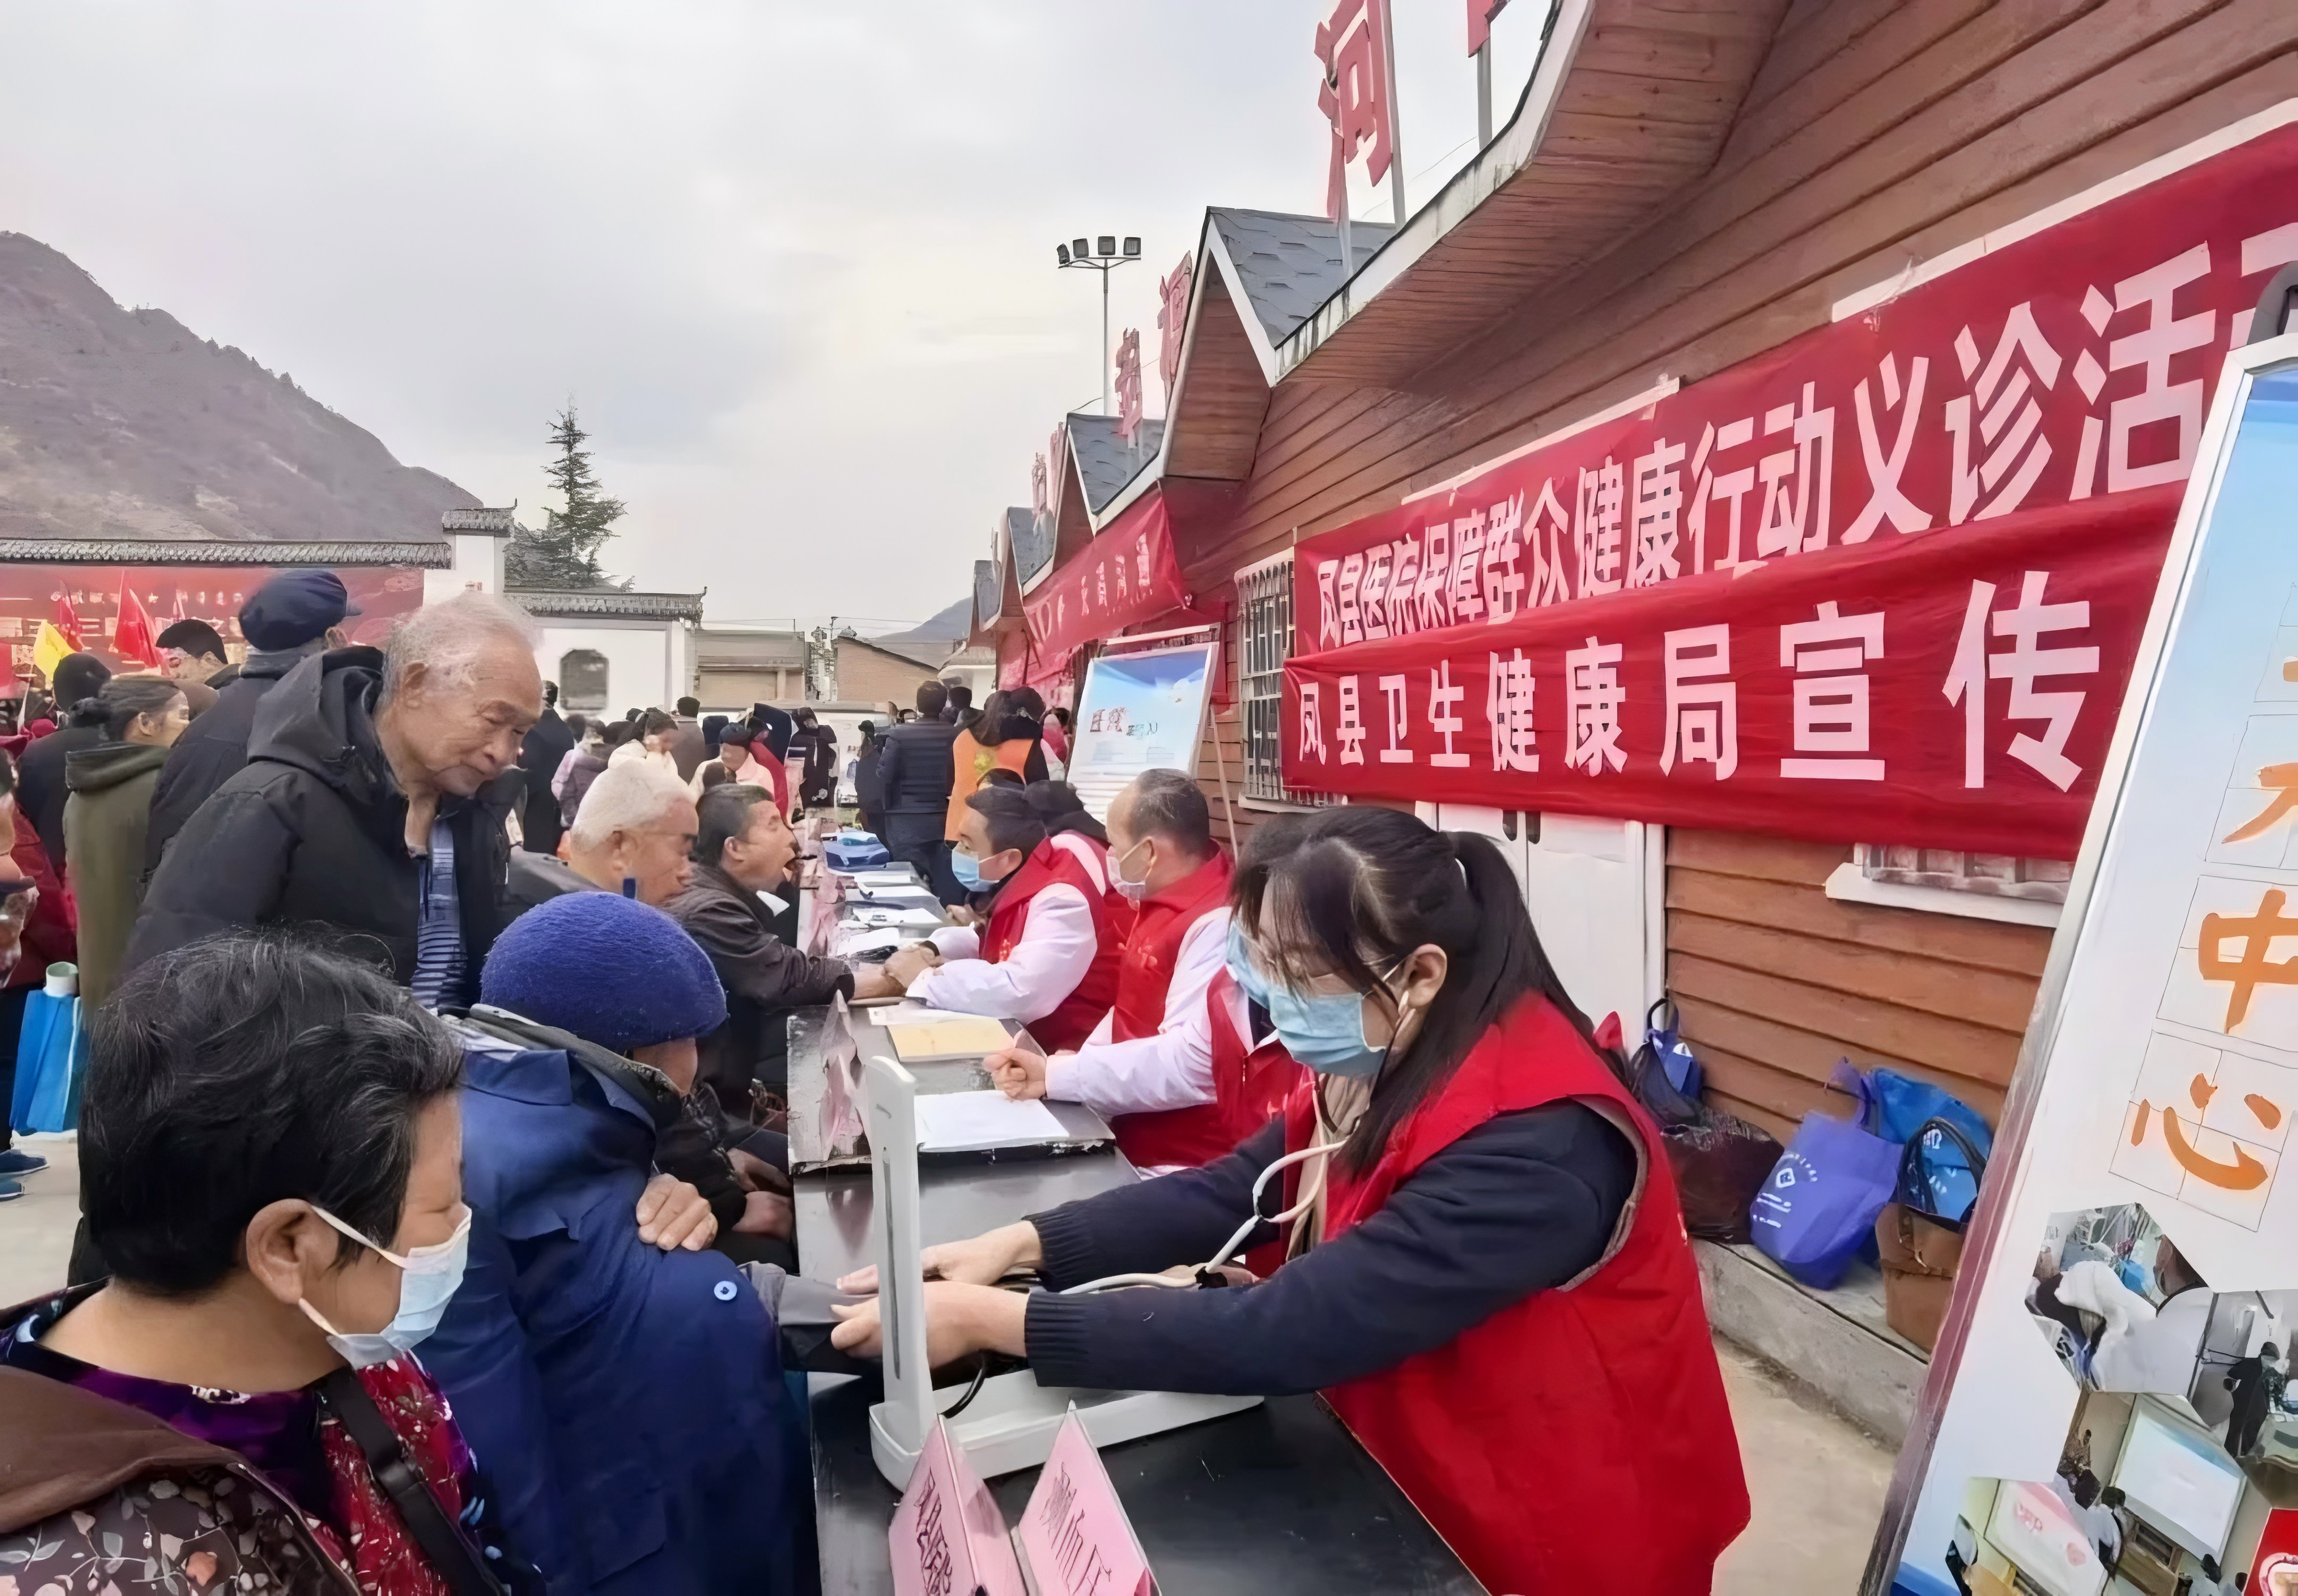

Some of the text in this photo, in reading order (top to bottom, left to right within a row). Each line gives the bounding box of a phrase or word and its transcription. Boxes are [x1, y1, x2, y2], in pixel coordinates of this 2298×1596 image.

[1300, 570, 2100, 793] 凤县卫生健康局宣传
